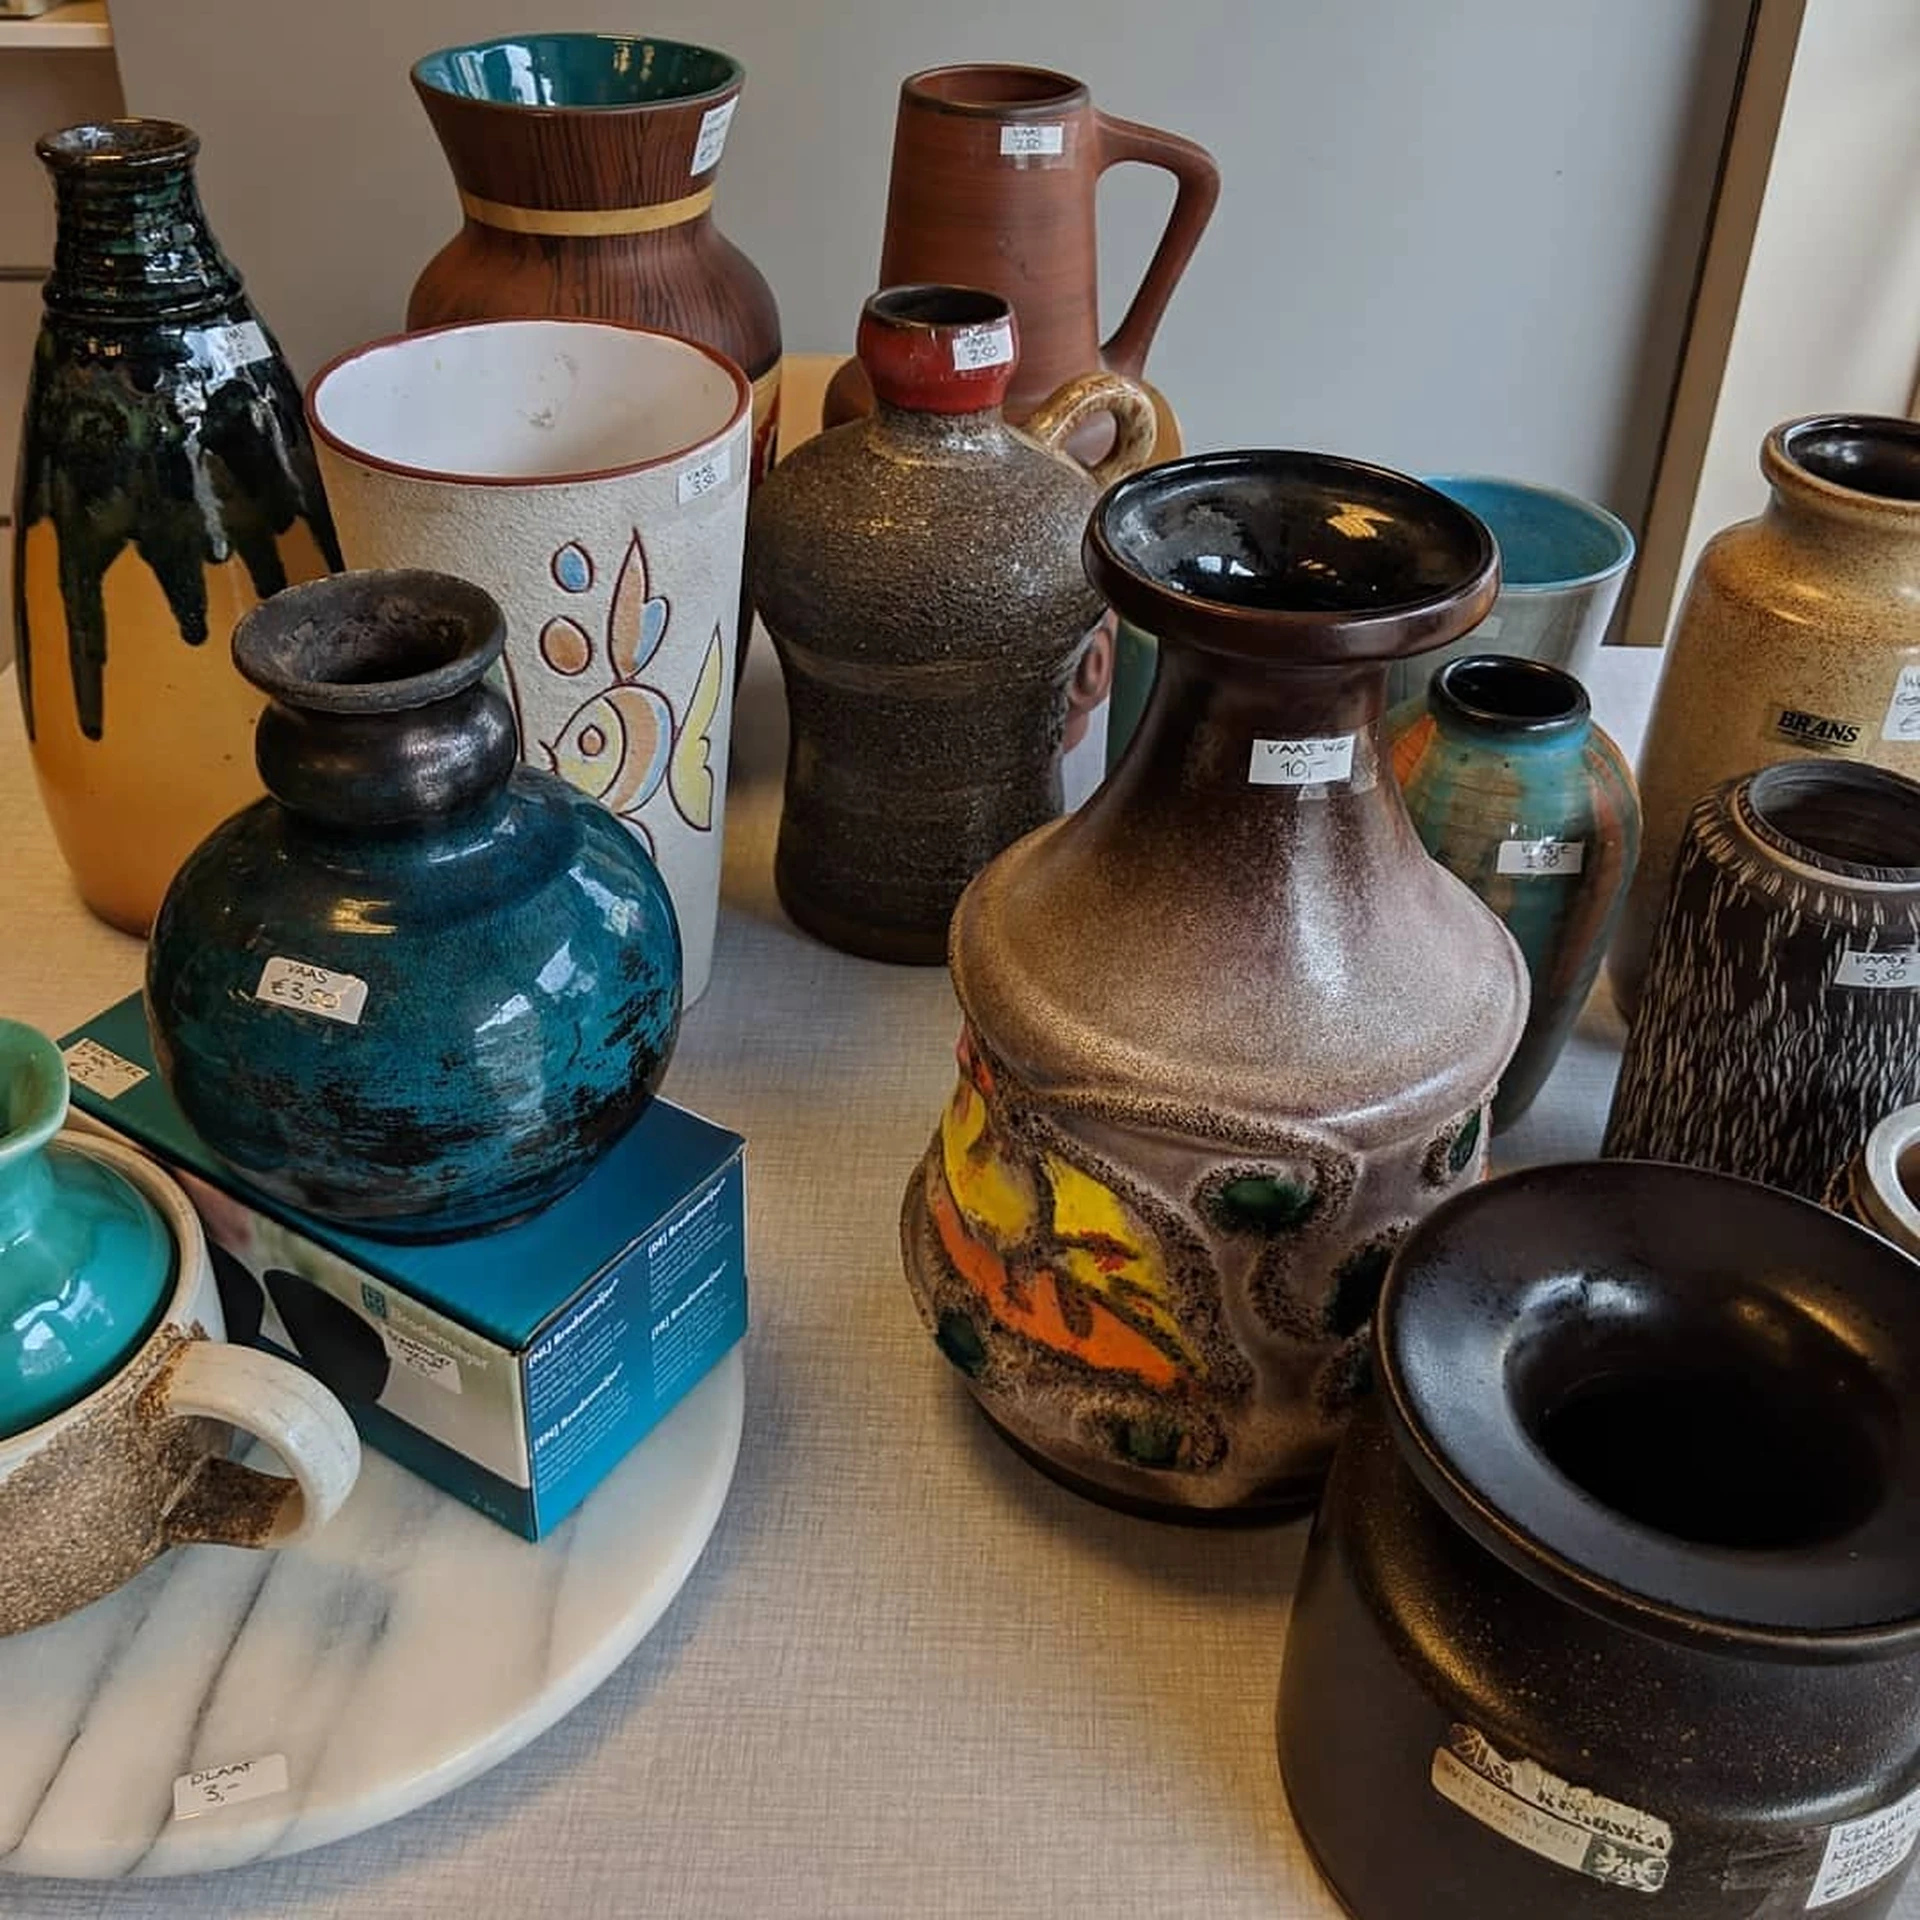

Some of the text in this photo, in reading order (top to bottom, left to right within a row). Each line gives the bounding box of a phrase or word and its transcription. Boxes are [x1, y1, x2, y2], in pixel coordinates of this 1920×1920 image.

[1778, 710, 1860, 742] BRANS
[1267, 743, 1314, 756] VAAS
[285, 962, 329, 984] VAAS
[191, 1761, 256, 1785] PLAAT
